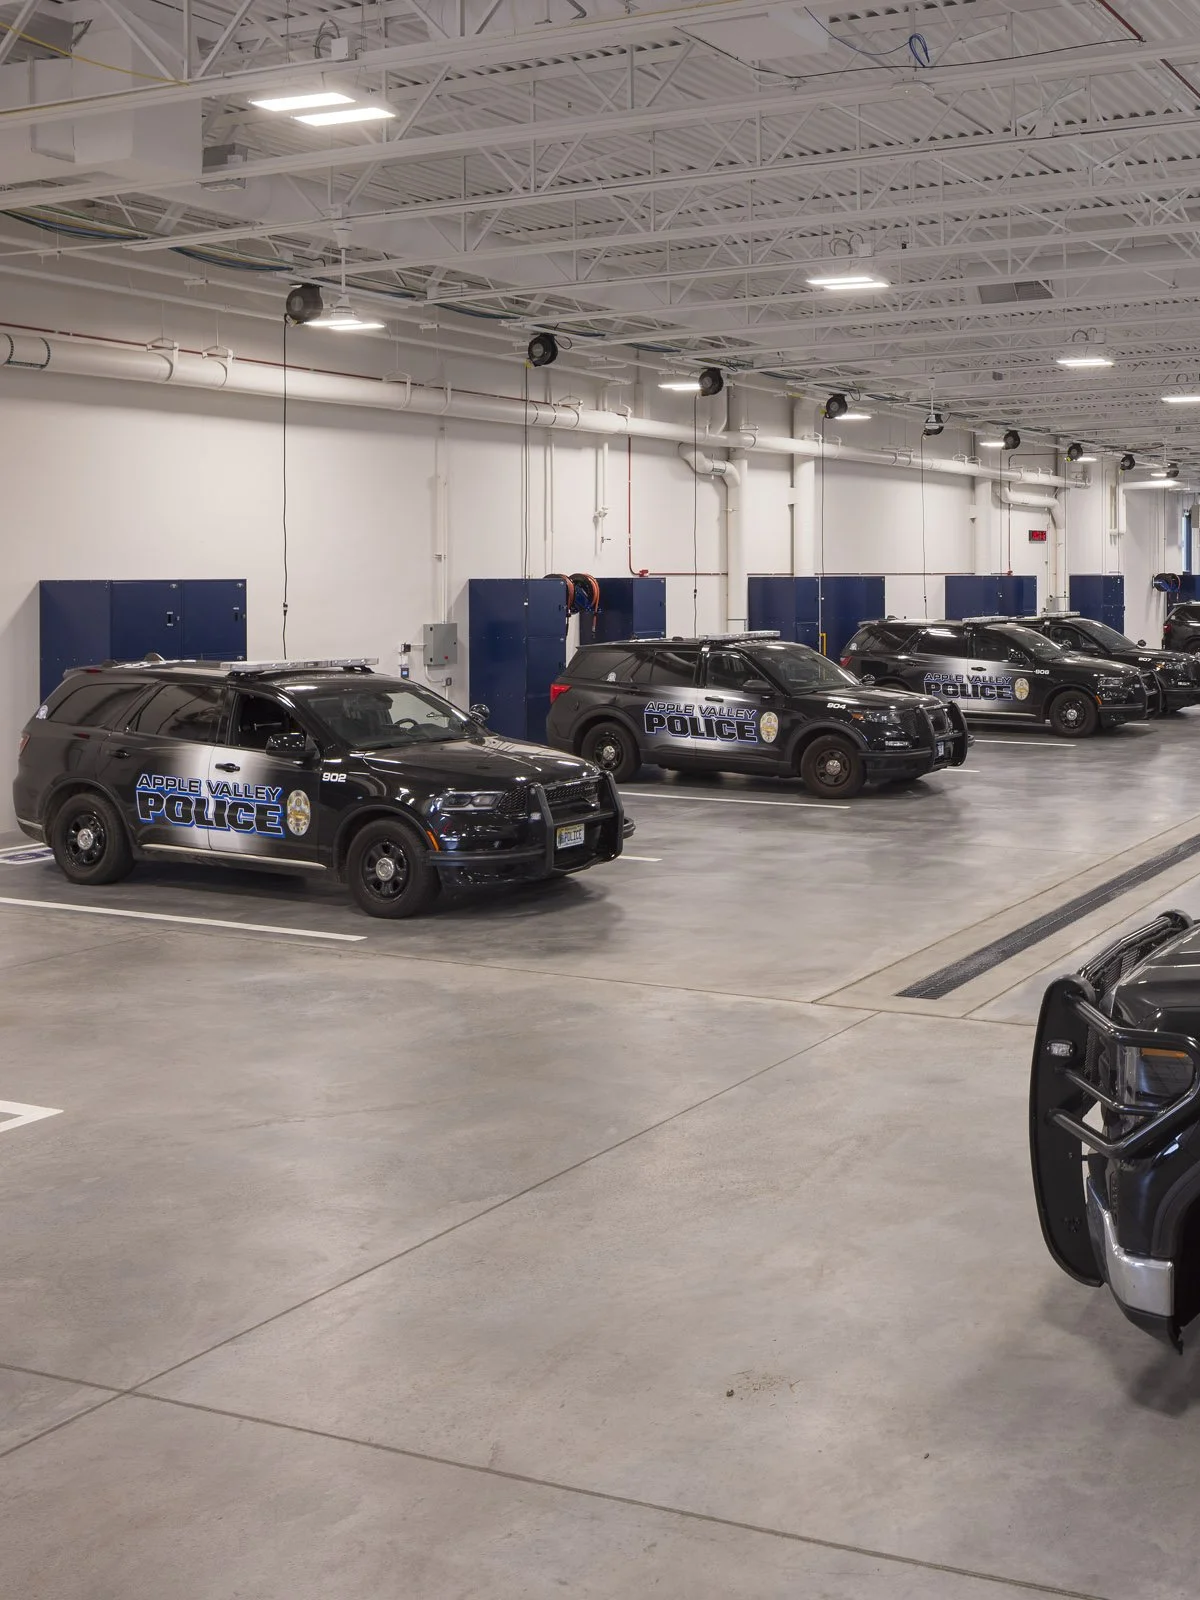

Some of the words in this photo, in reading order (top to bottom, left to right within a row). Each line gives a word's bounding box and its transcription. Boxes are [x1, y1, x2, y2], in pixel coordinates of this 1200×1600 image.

[924, 673, 963, 682] APPLE
[966, 674, 1012, 684] VALLEY
[924, 681, 1013, 700] POLICE
[645, 702, 695, 715] APPLE
[699, 704, 757, 719] VALLEY
[644, 713, 758, 742] POLICE
[322, 772, 346, 782] 902
[136, 774, 201, 794] APPLE
[206, 780, 283, 801] VALLEY
[135, 789, 285, 837] POLICE
